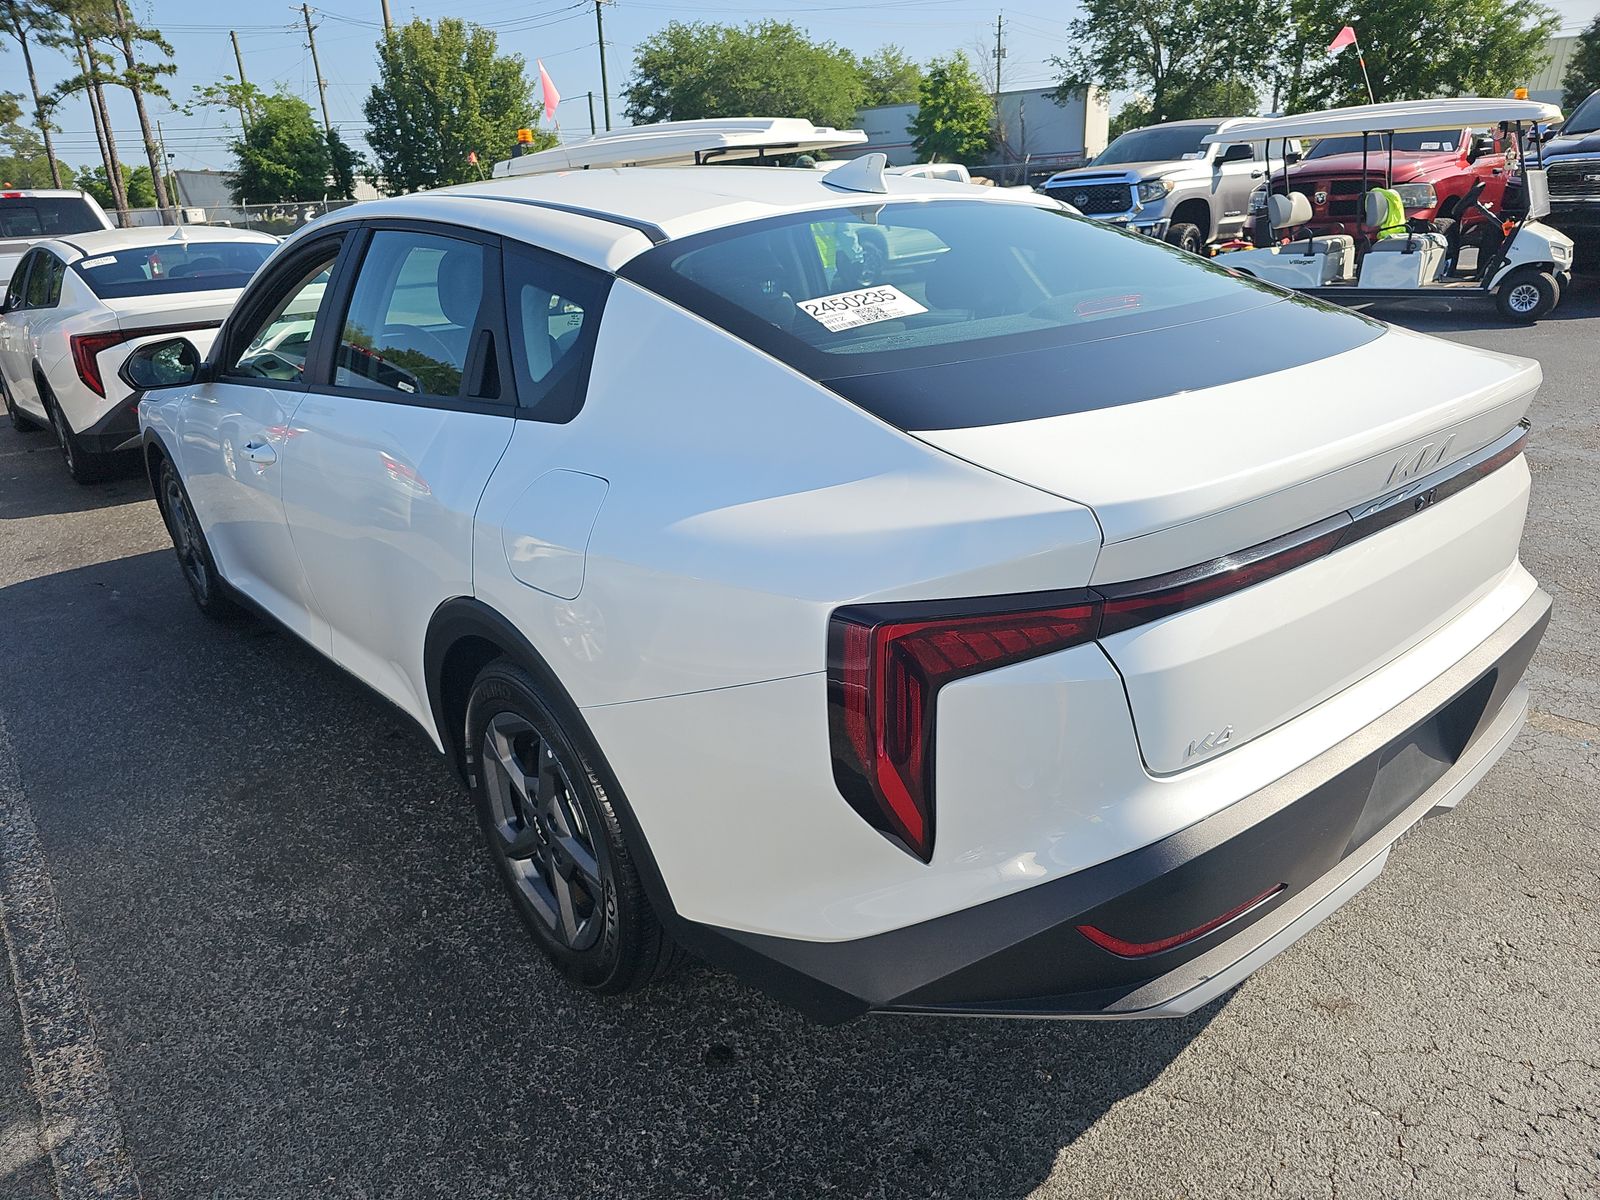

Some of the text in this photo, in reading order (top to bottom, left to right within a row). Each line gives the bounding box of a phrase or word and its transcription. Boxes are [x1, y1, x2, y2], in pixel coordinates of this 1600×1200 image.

[804, 289, 897, 317] 2450235
[1385, 433, 1457, 485] KIA
[1184, 724, 1234, 757] K4
